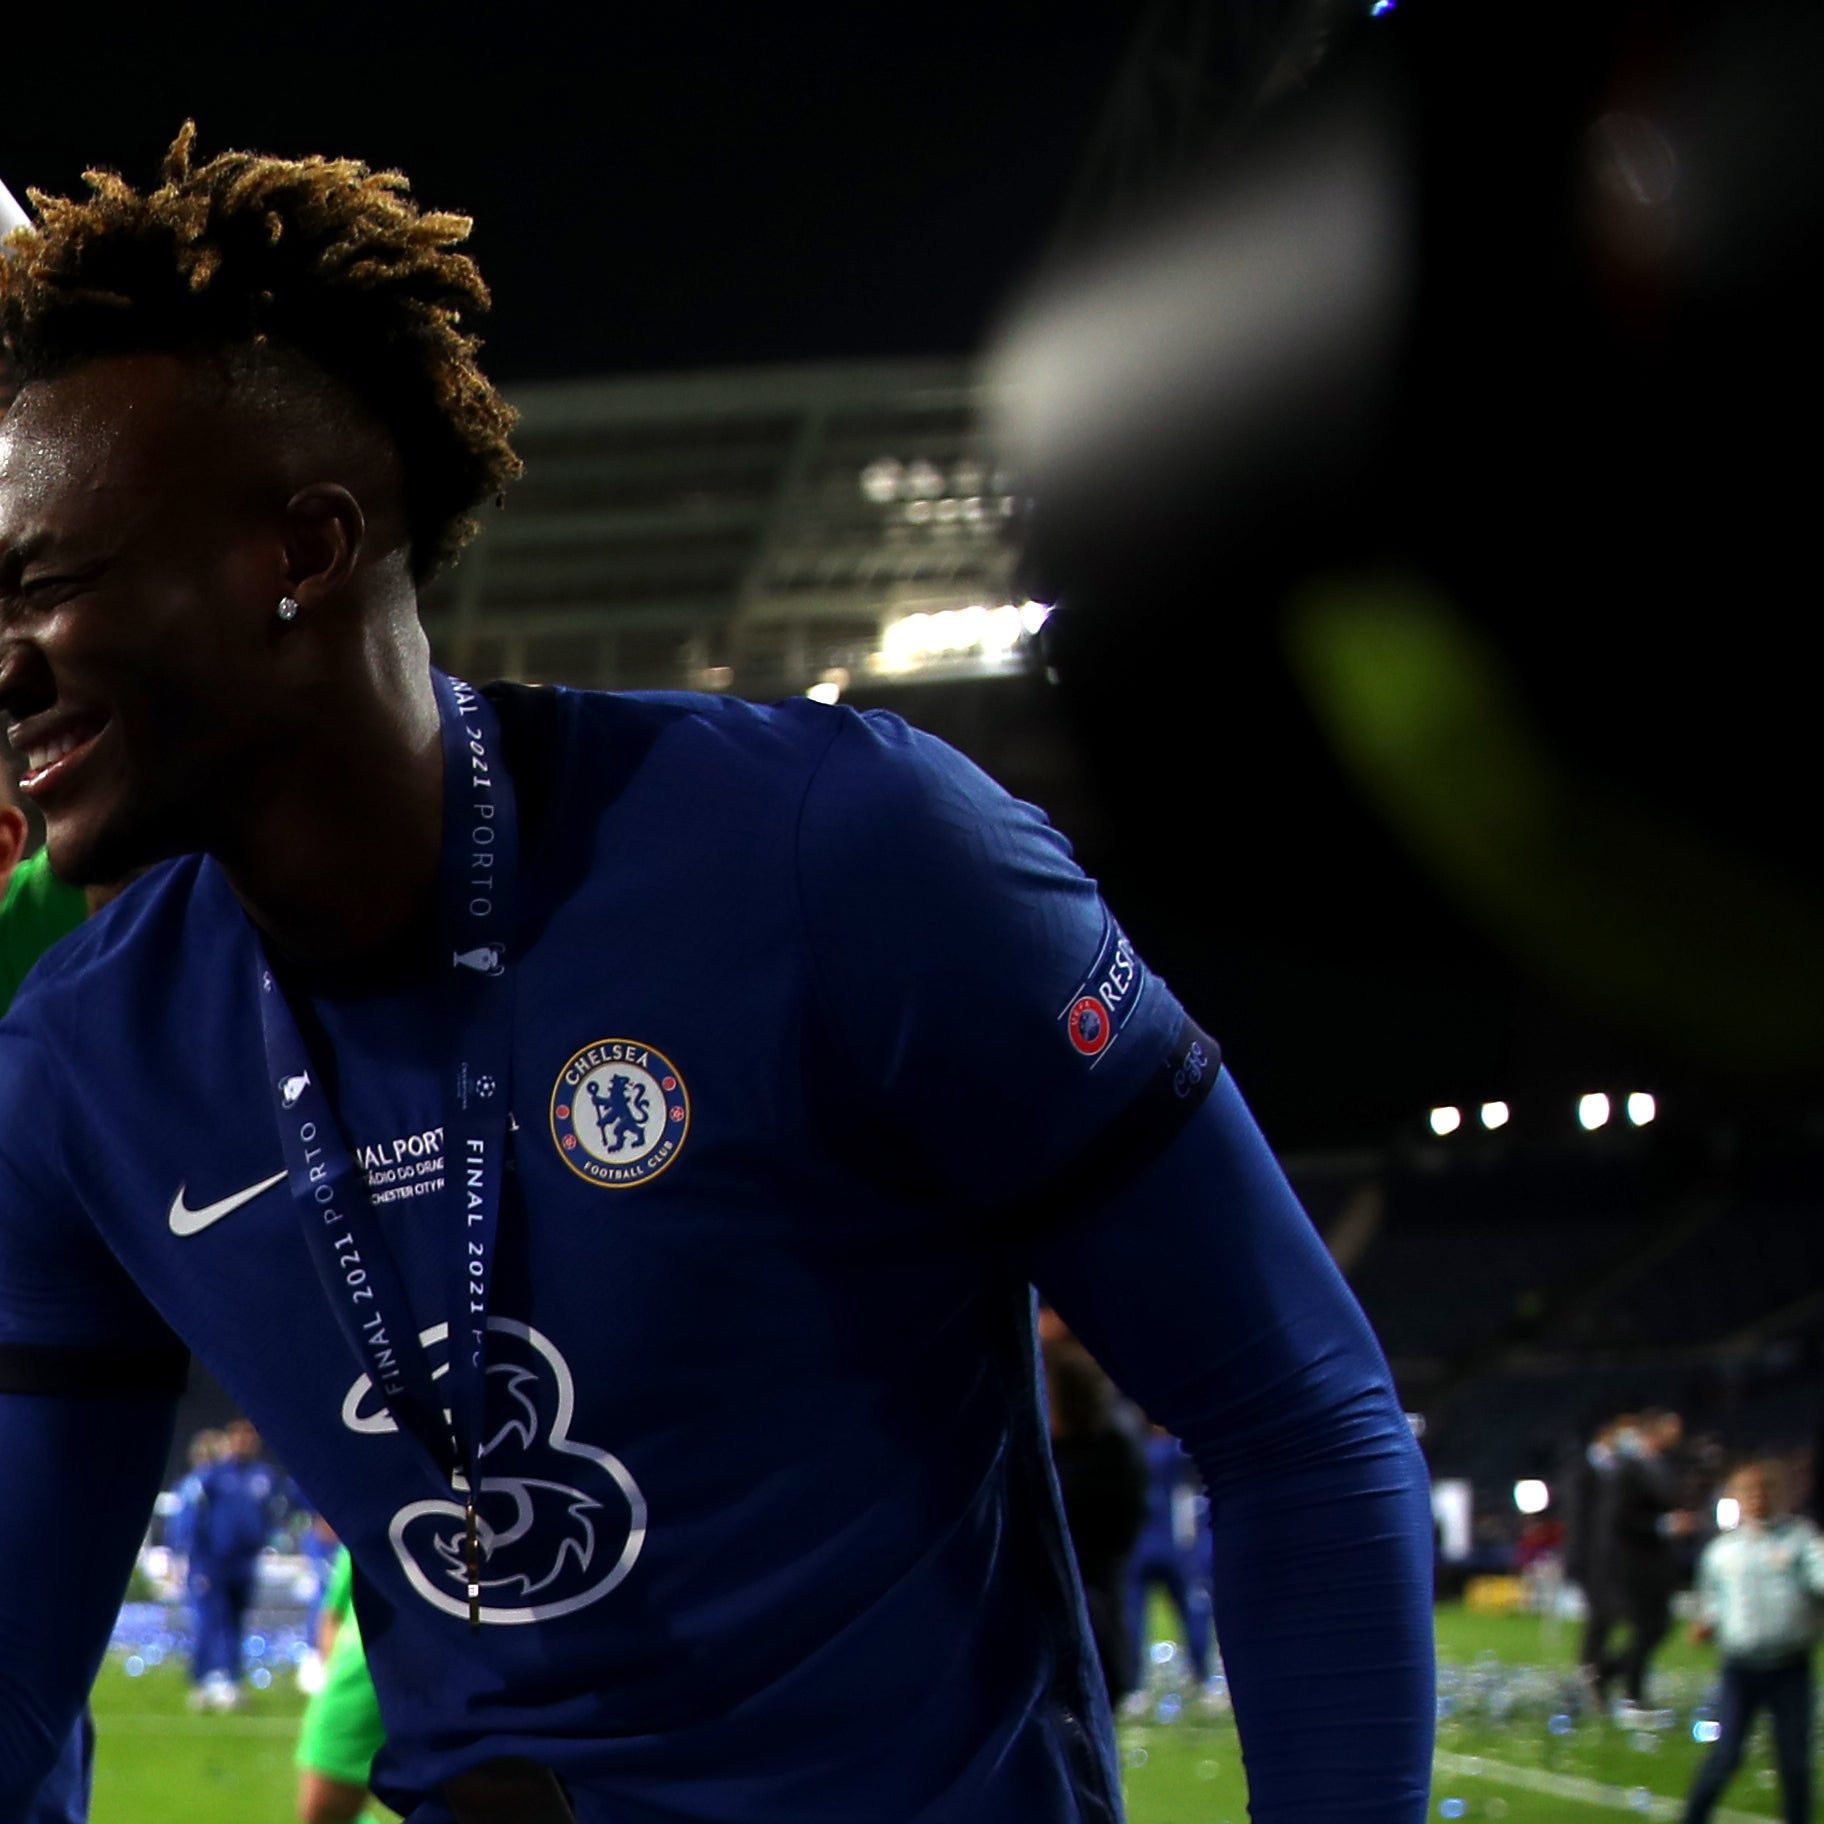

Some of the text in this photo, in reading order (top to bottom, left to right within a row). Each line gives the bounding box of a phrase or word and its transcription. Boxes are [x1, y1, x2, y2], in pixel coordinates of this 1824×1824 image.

[465, 725, 492, 789] 2021
[468, 803, 495, 917] PORTO
[1098, 938, 1137, 1012] RESP
[564, 1044, 649, 1087] CHELSEA
[392, 1126, 445, 1164] PORT
[583, 1140, 674, 1180] FOOTBALL CLUB
[465, 1138, 486, 1228] FINAL
[300, 1121, 405, 1398] FINAL 2021 PORTO
[468, 1240, 486, 1315] 2021
